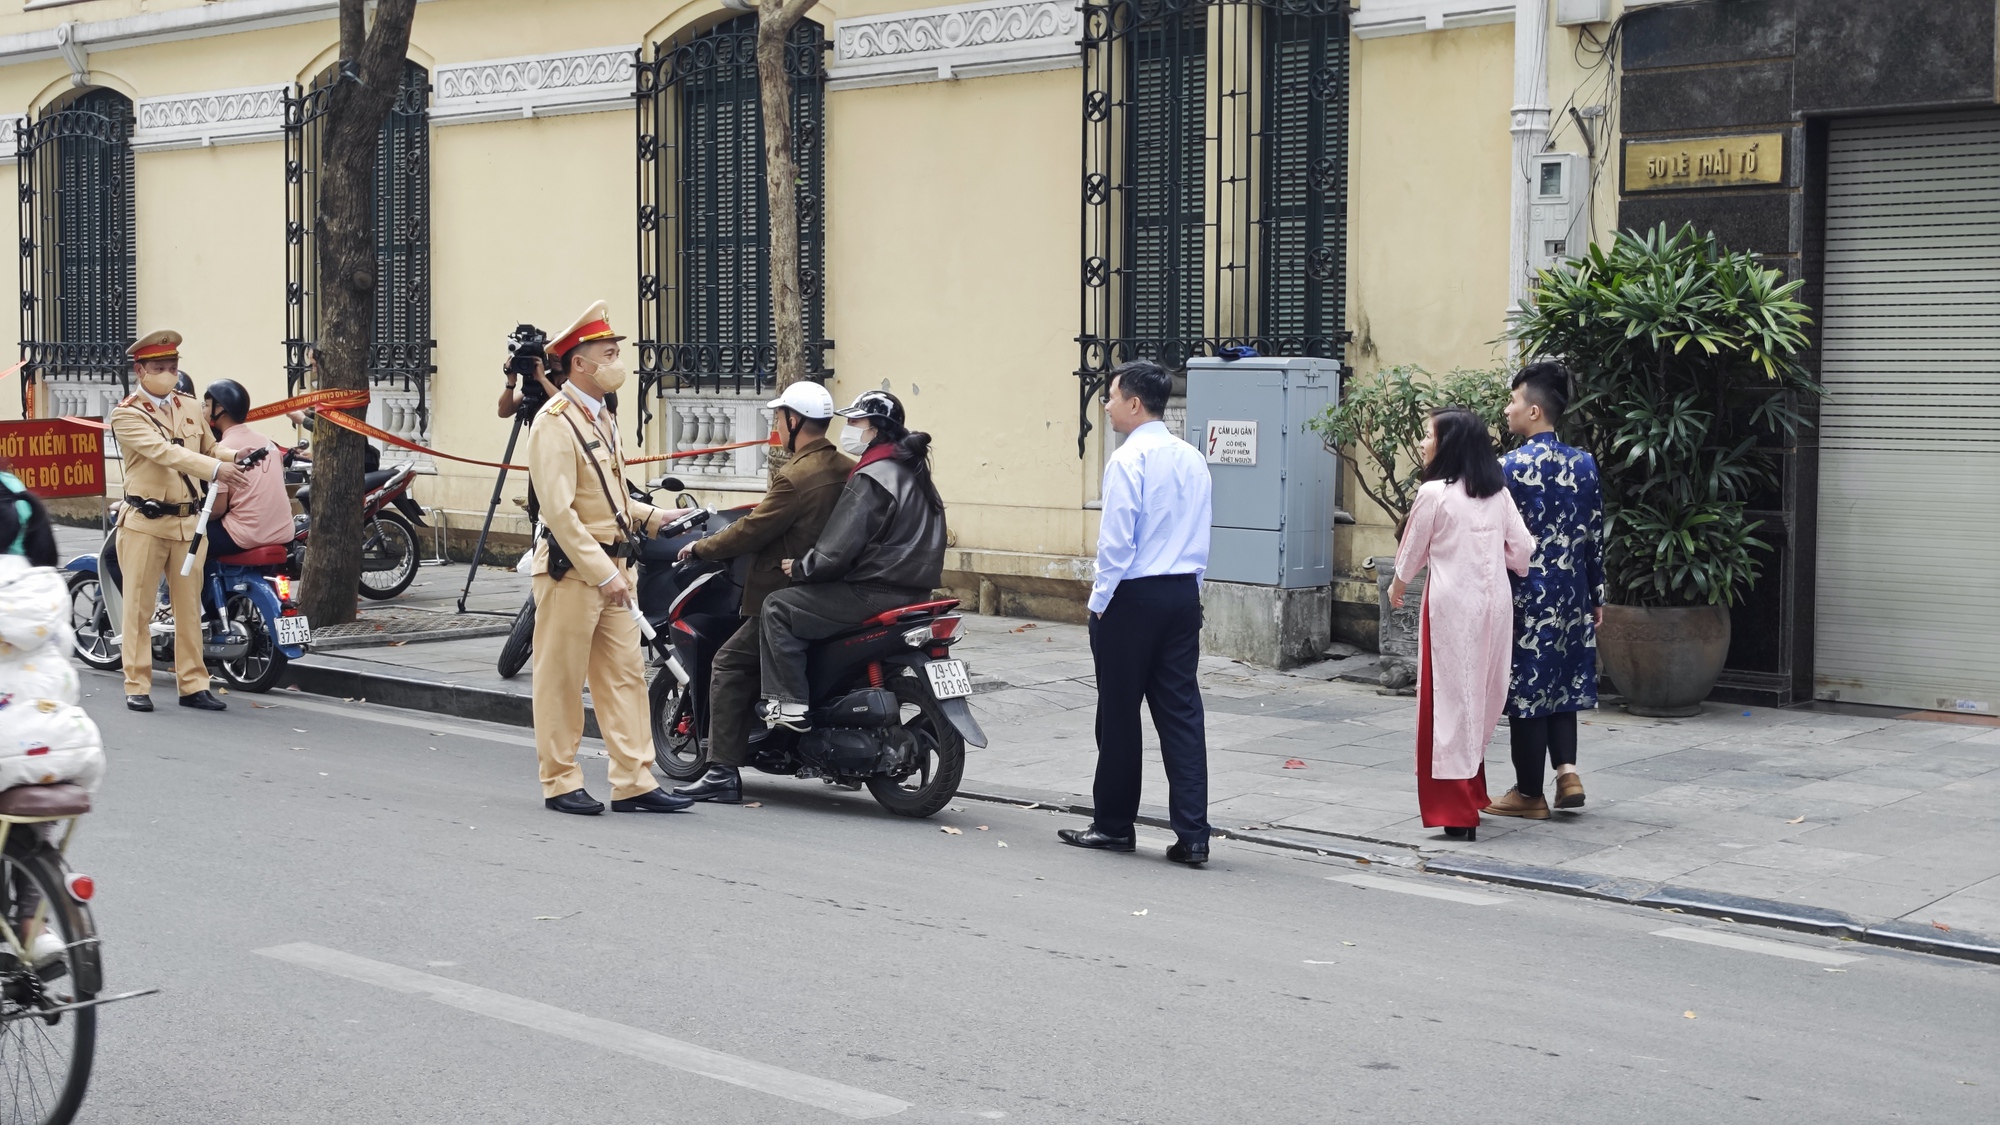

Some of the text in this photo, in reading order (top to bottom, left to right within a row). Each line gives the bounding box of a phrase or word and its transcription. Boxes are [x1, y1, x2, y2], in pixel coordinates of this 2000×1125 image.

[1647, 156, 1667, 178] 50
[0, 427, 97, 457] HỐT KIỂM TRA
[40, 462, 60, 490] ĐỘ
[64, 459, 94, 486] CỒN
[280, 618, 304, 630] 29-AC
[932, 662, 961, 679] 29-C1
